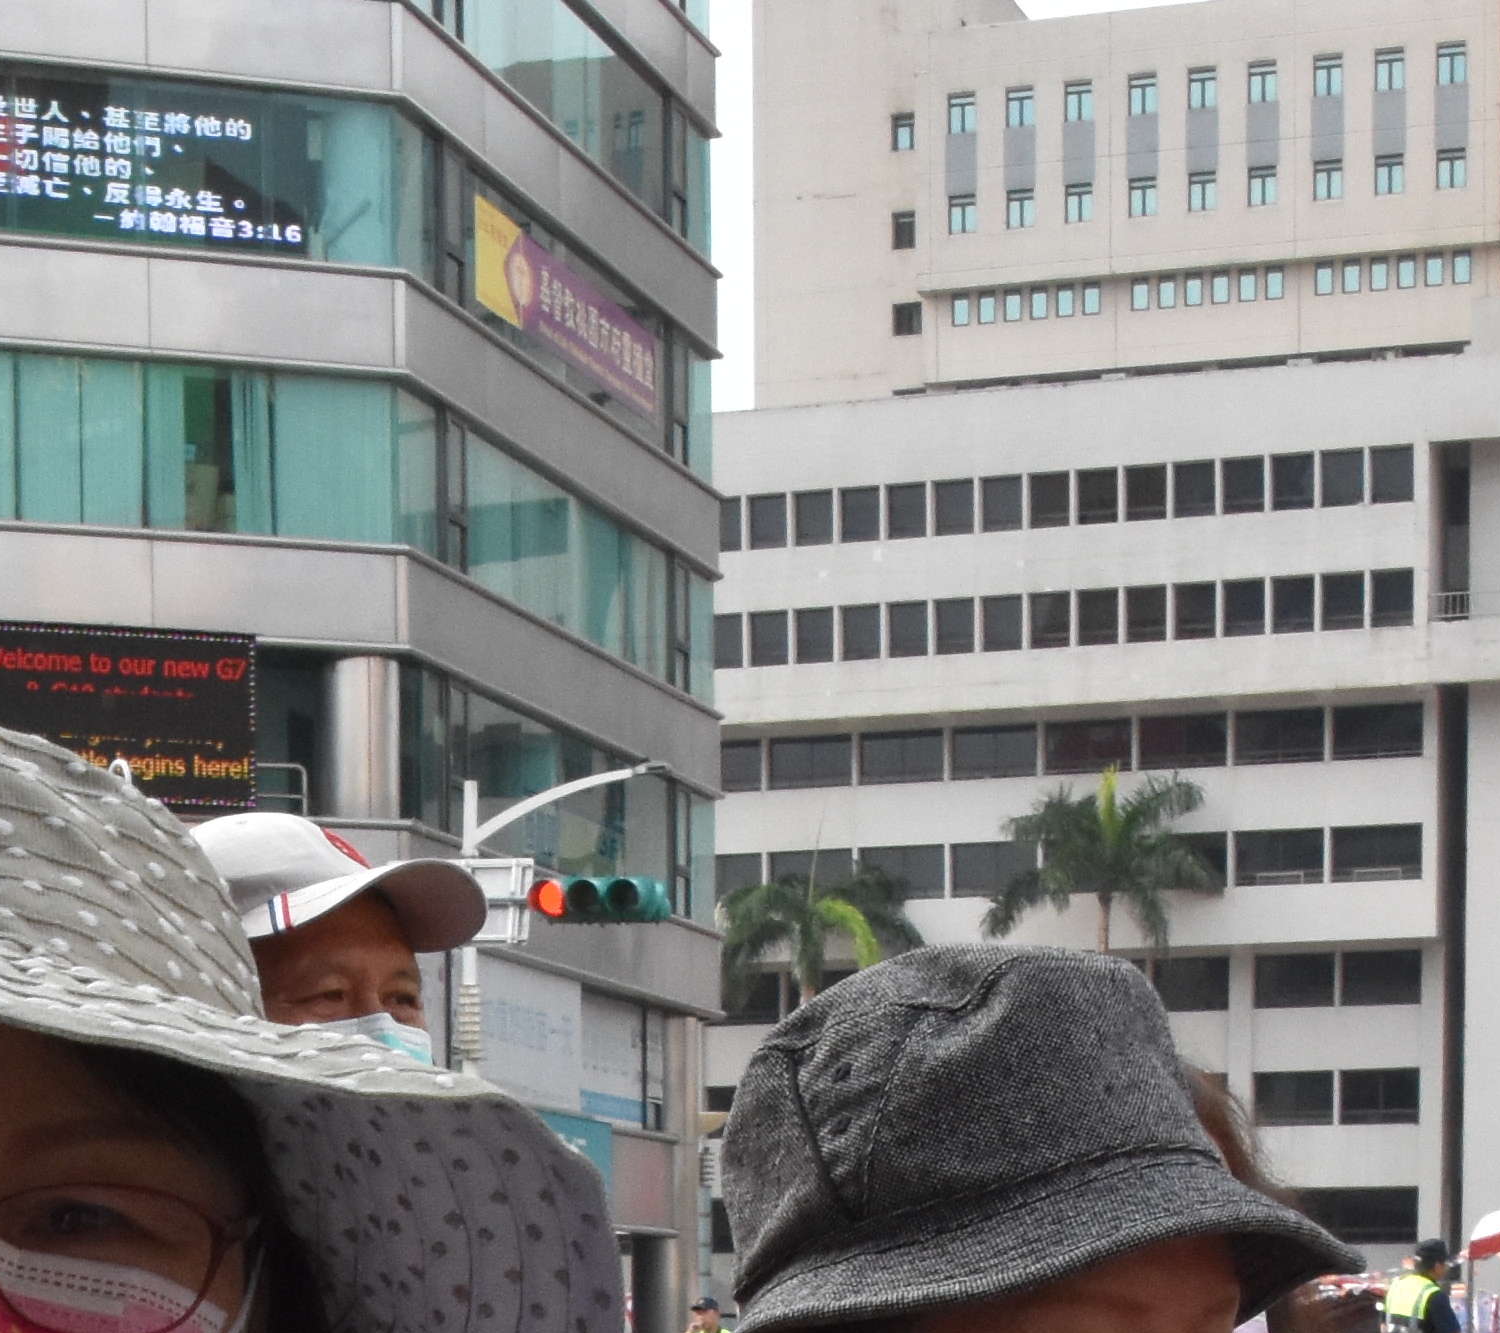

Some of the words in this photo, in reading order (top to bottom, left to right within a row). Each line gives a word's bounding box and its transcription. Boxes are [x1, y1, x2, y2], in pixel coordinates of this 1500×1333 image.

[89, 651, 113, 675] to
[117, 656, 156, 676] our
[162, 659, 210, 679] new
[215, 656, 248, 682] G7
[193, 754, 249, 780] here!
